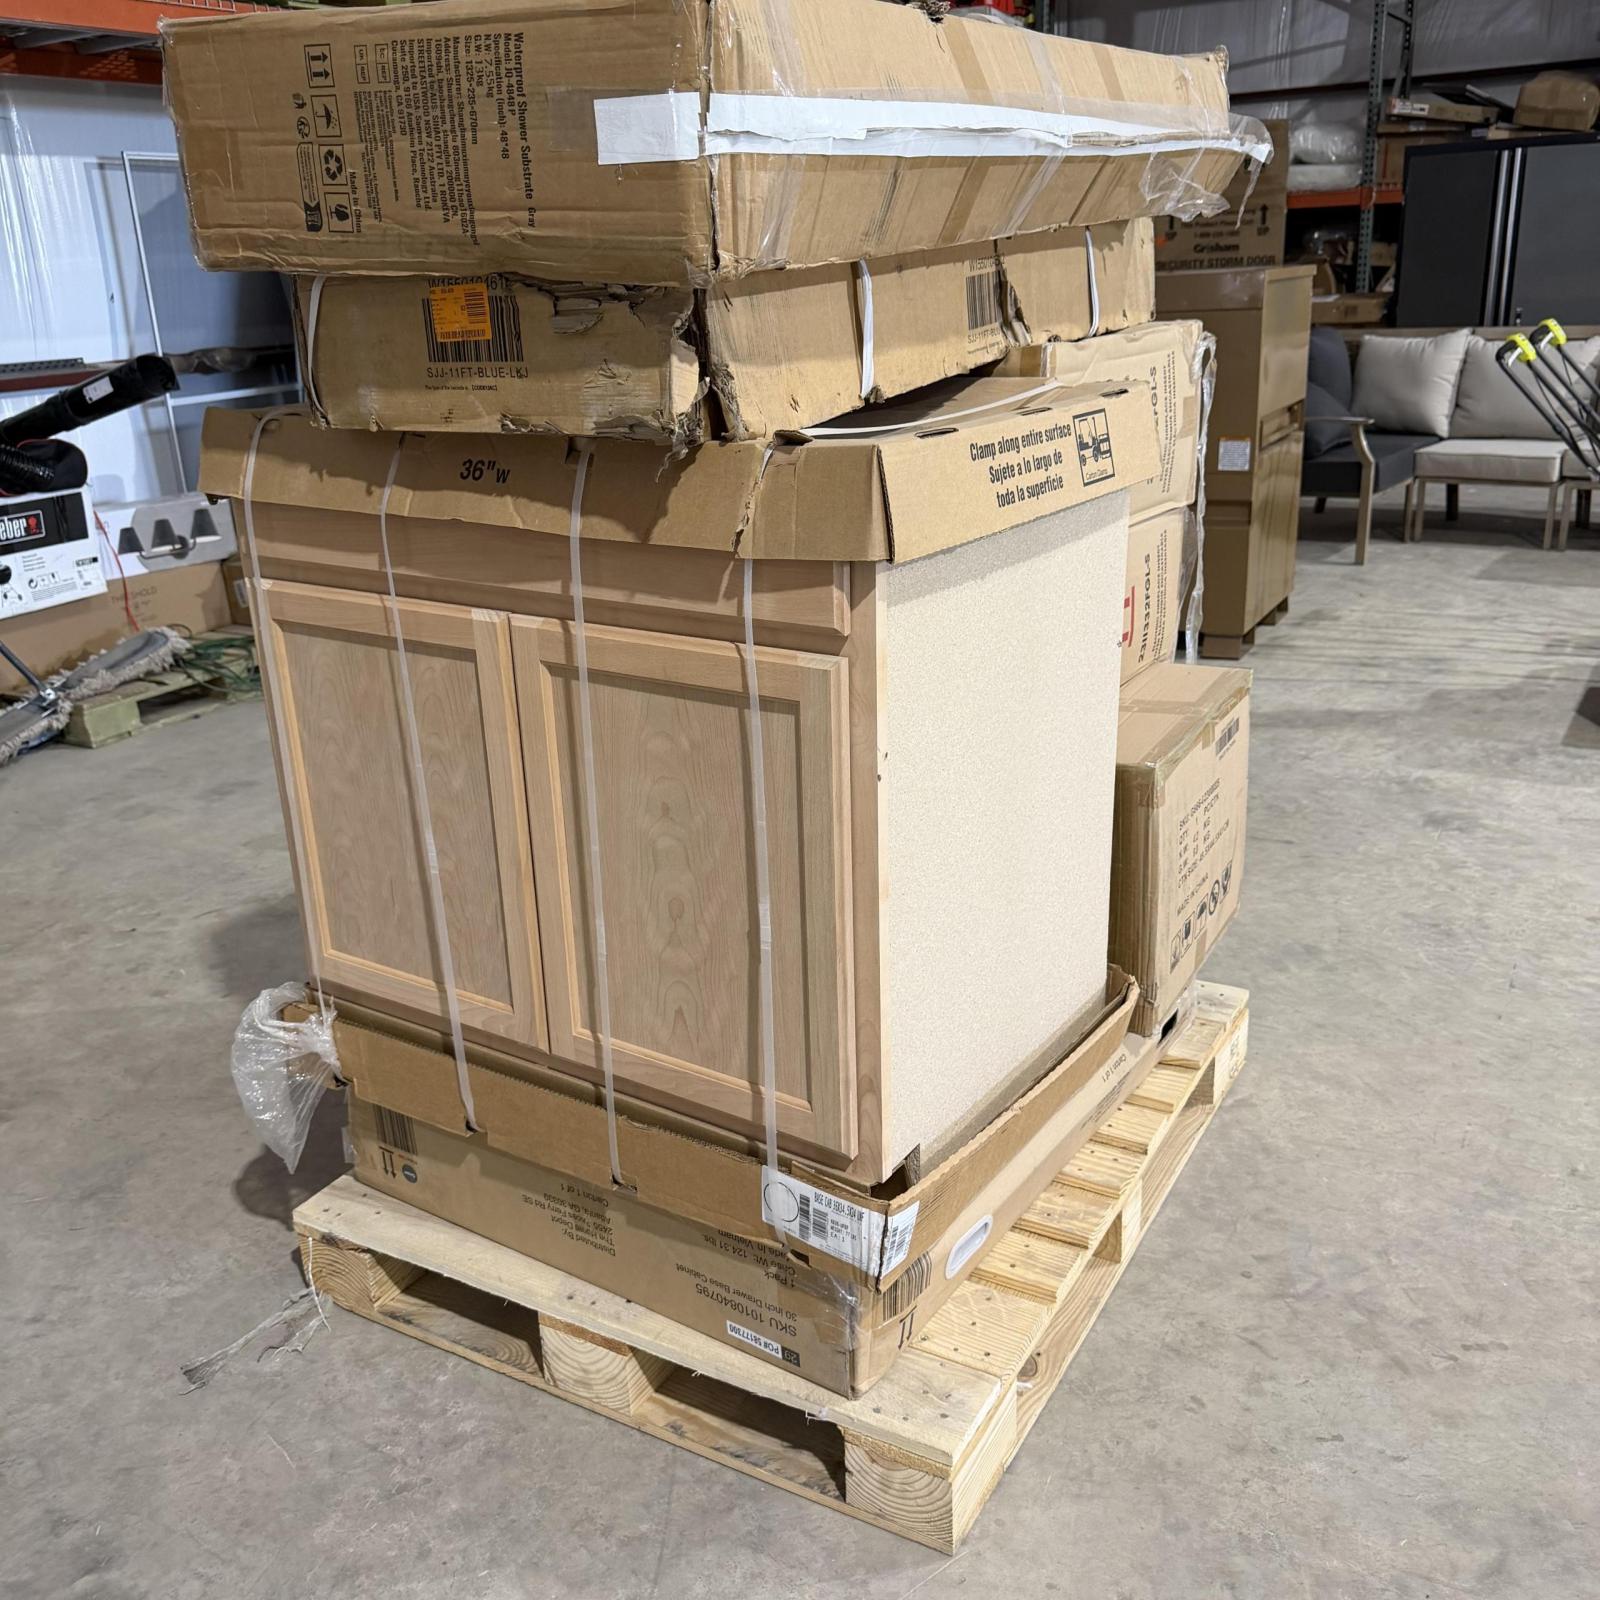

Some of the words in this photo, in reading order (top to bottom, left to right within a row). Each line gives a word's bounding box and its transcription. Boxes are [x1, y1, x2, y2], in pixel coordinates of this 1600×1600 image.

[398, 39, 407, 62] Suite
[442, 36, 451, 74] Address:
[463, 34, 473, 56] Size:
[473, 34, 482, 55] G.W:
[482, 34, 492, 55] N.W:
[502, 32, 512, 64] Model:
[390, 40, 401, 92] Cucamonga,
[407, 38, 418, 78] Imported
[424, 37, 434, 78] Imported
[451, 36, 463, 100] Manufacturer:
[490, 33, 506, 94] Specification
[511, 32, 527, 96] Waterproof
[411, 81, 419, 90] to
[428, 80, 436, 90] to
[395, 94, 403, 106] CA
[411, 92, 422, 112] USA:
[428, 92, 438, 112] AUS:
[397, 108, 406, 135] 91730
[496, 98, 506, 128] (inch):
[517, 101, 529, 140] Shower
[404, 111, 418, 147] Anaheim
[423, 119, 432, 138] NSW
[431, 114, 441, 140] SIHAO
[425, 141, 435, 162] 2122
[433, 143, 442, 159] PTY
[440, 129, 452, 164] shanghai
[408, 150, 420, 175] Place,
[415, 148, 430, 193] Technology
[435, 162, 444, 179] LTD.
[520, 145, 534, 199] Substrate
[348, 171, 358, 194] Made
[412, 177, 424, 207] Rancho
[427, 166, 439, 202] Australia
[445, 170, 456, 202] 200000
[351, 197, 359, 205] in
[423, 196, 431, 211] Ltd.
[353, 208, 362, 233] China
[526, 207, 536, 227] Gray
[1194, 243, 1240, 254] Grisham
[1208, 256, 1244, 268] STORM
[1246, 255, 1276, 266] DOOR
[970, 442, 997, 461] Clamp
[998, 434, 1020, 454] along
[1022, 428, 1044, 448] entire
[1044, 422, 1072, 446] surface
[988, 464, 1016, 485] Sujete
[1017, 462, 1022, 476] a
[1023, 457, 1032, 474] lo
[1032, 454, 1052, 472] largo
[1053, 449, 1063, 465] de
[996, 486, 1016, 508] toda
[1016, 484, 1026, 501] la
[1026, 473, 1064, 500] superficie
[0, 517, 26, 541] eber
[567, 1185, 576, 1194] of
[582, 1190, 608, 1207] Carton
[814, 1191, 823, 1205] BASE
[534, 1199, 545, 1209] Rd
[547, 1202, 566, 1217] Ferry
[568, 1201, 580, 1213] GA
[551, 1215, 573, 1230] Depot
[582, 1206, 610, 1224] Atlanta,
[561, 1227, 573, 1240] By:
[575, 1224, 596, 1239] Home
[599, 1232, 613, 1246] The
[575, 1233, 615, 1256] Distributed
[719, 1240, 746, 1258] 124.31
[753, 1253, 767, 1266] Wt:
[770, 1258, 795, 1277] Case
[676, 1262, 707, 1283] Cabinet
[764, 1269, 787, 1285] Pack
[709, 1277, 730, 1293] Base
[695, 1281, 763, 1323] 1010840795
[732, 1287, 762, 1308] Drawer
[785, 1309, 797, 1322] 30
[769, 1316, 796, 1337] SKU
[763, 1340, 778, 1354] PO#
[784, 1349, 796, 1363] 29
